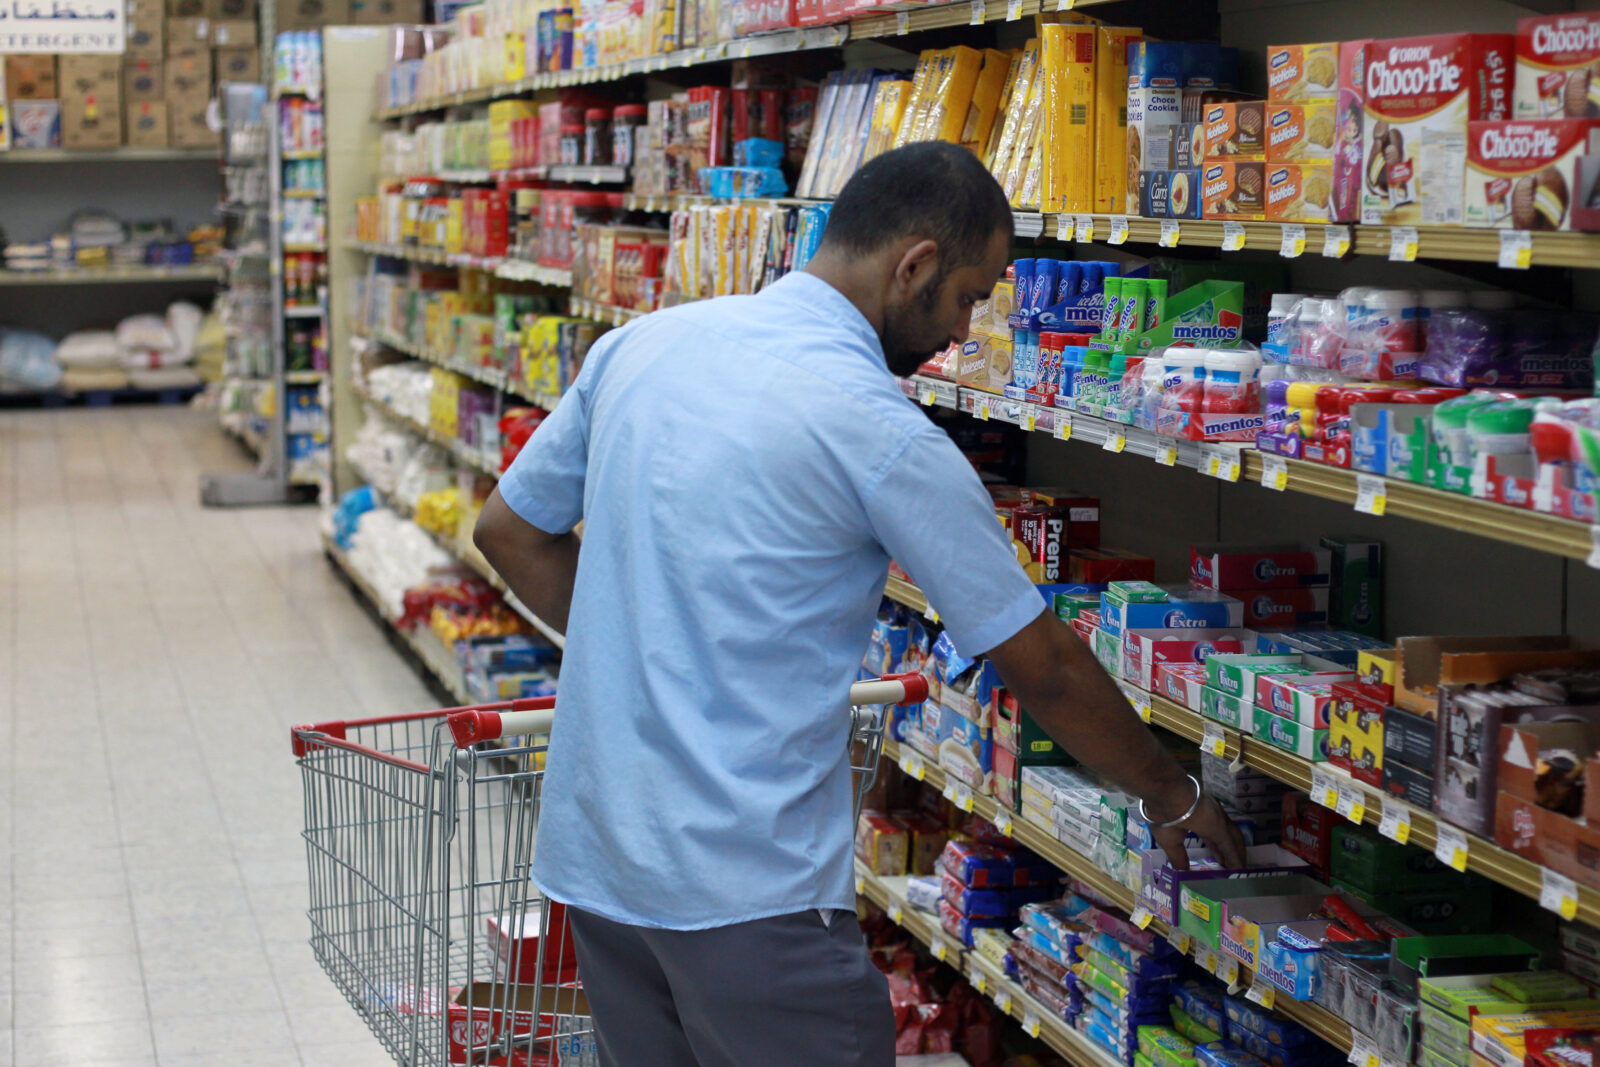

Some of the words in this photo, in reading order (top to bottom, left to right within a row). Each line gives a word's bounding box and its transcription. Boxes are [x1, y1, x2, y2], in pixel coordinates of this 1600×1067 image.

[1270, 66, 1298, 87] HobNobs
[1147, 104, 1180, 112] Cookies
[1151, 96, 1176, 104] Choco
[1270, 126, 1299, 147] HobNobs
[1269, 184, 1297, 205] HobNobs
[1173, 325, 1238, 339] mentos
[1523, 355, 1590, 371] mentos
[1205, 416, 1264, 436] mentos
[1046, 519, 1063, 581] Prens
[1260, 563, 1296, 577] Extra
[1258, 600, 1293, 614] Extra
[1169, 615, 1207, 628] Extra
[1219, 670, 1239, 689] Extra
[1274, 693, 1295, 711] Extra
[1273, 726, 1294, 746] Extra
[1152, 887, 1172, 908] SMINT
[1221, 933, 1254, 966] mentos
[1260, 962, 1296, 994] mentos
